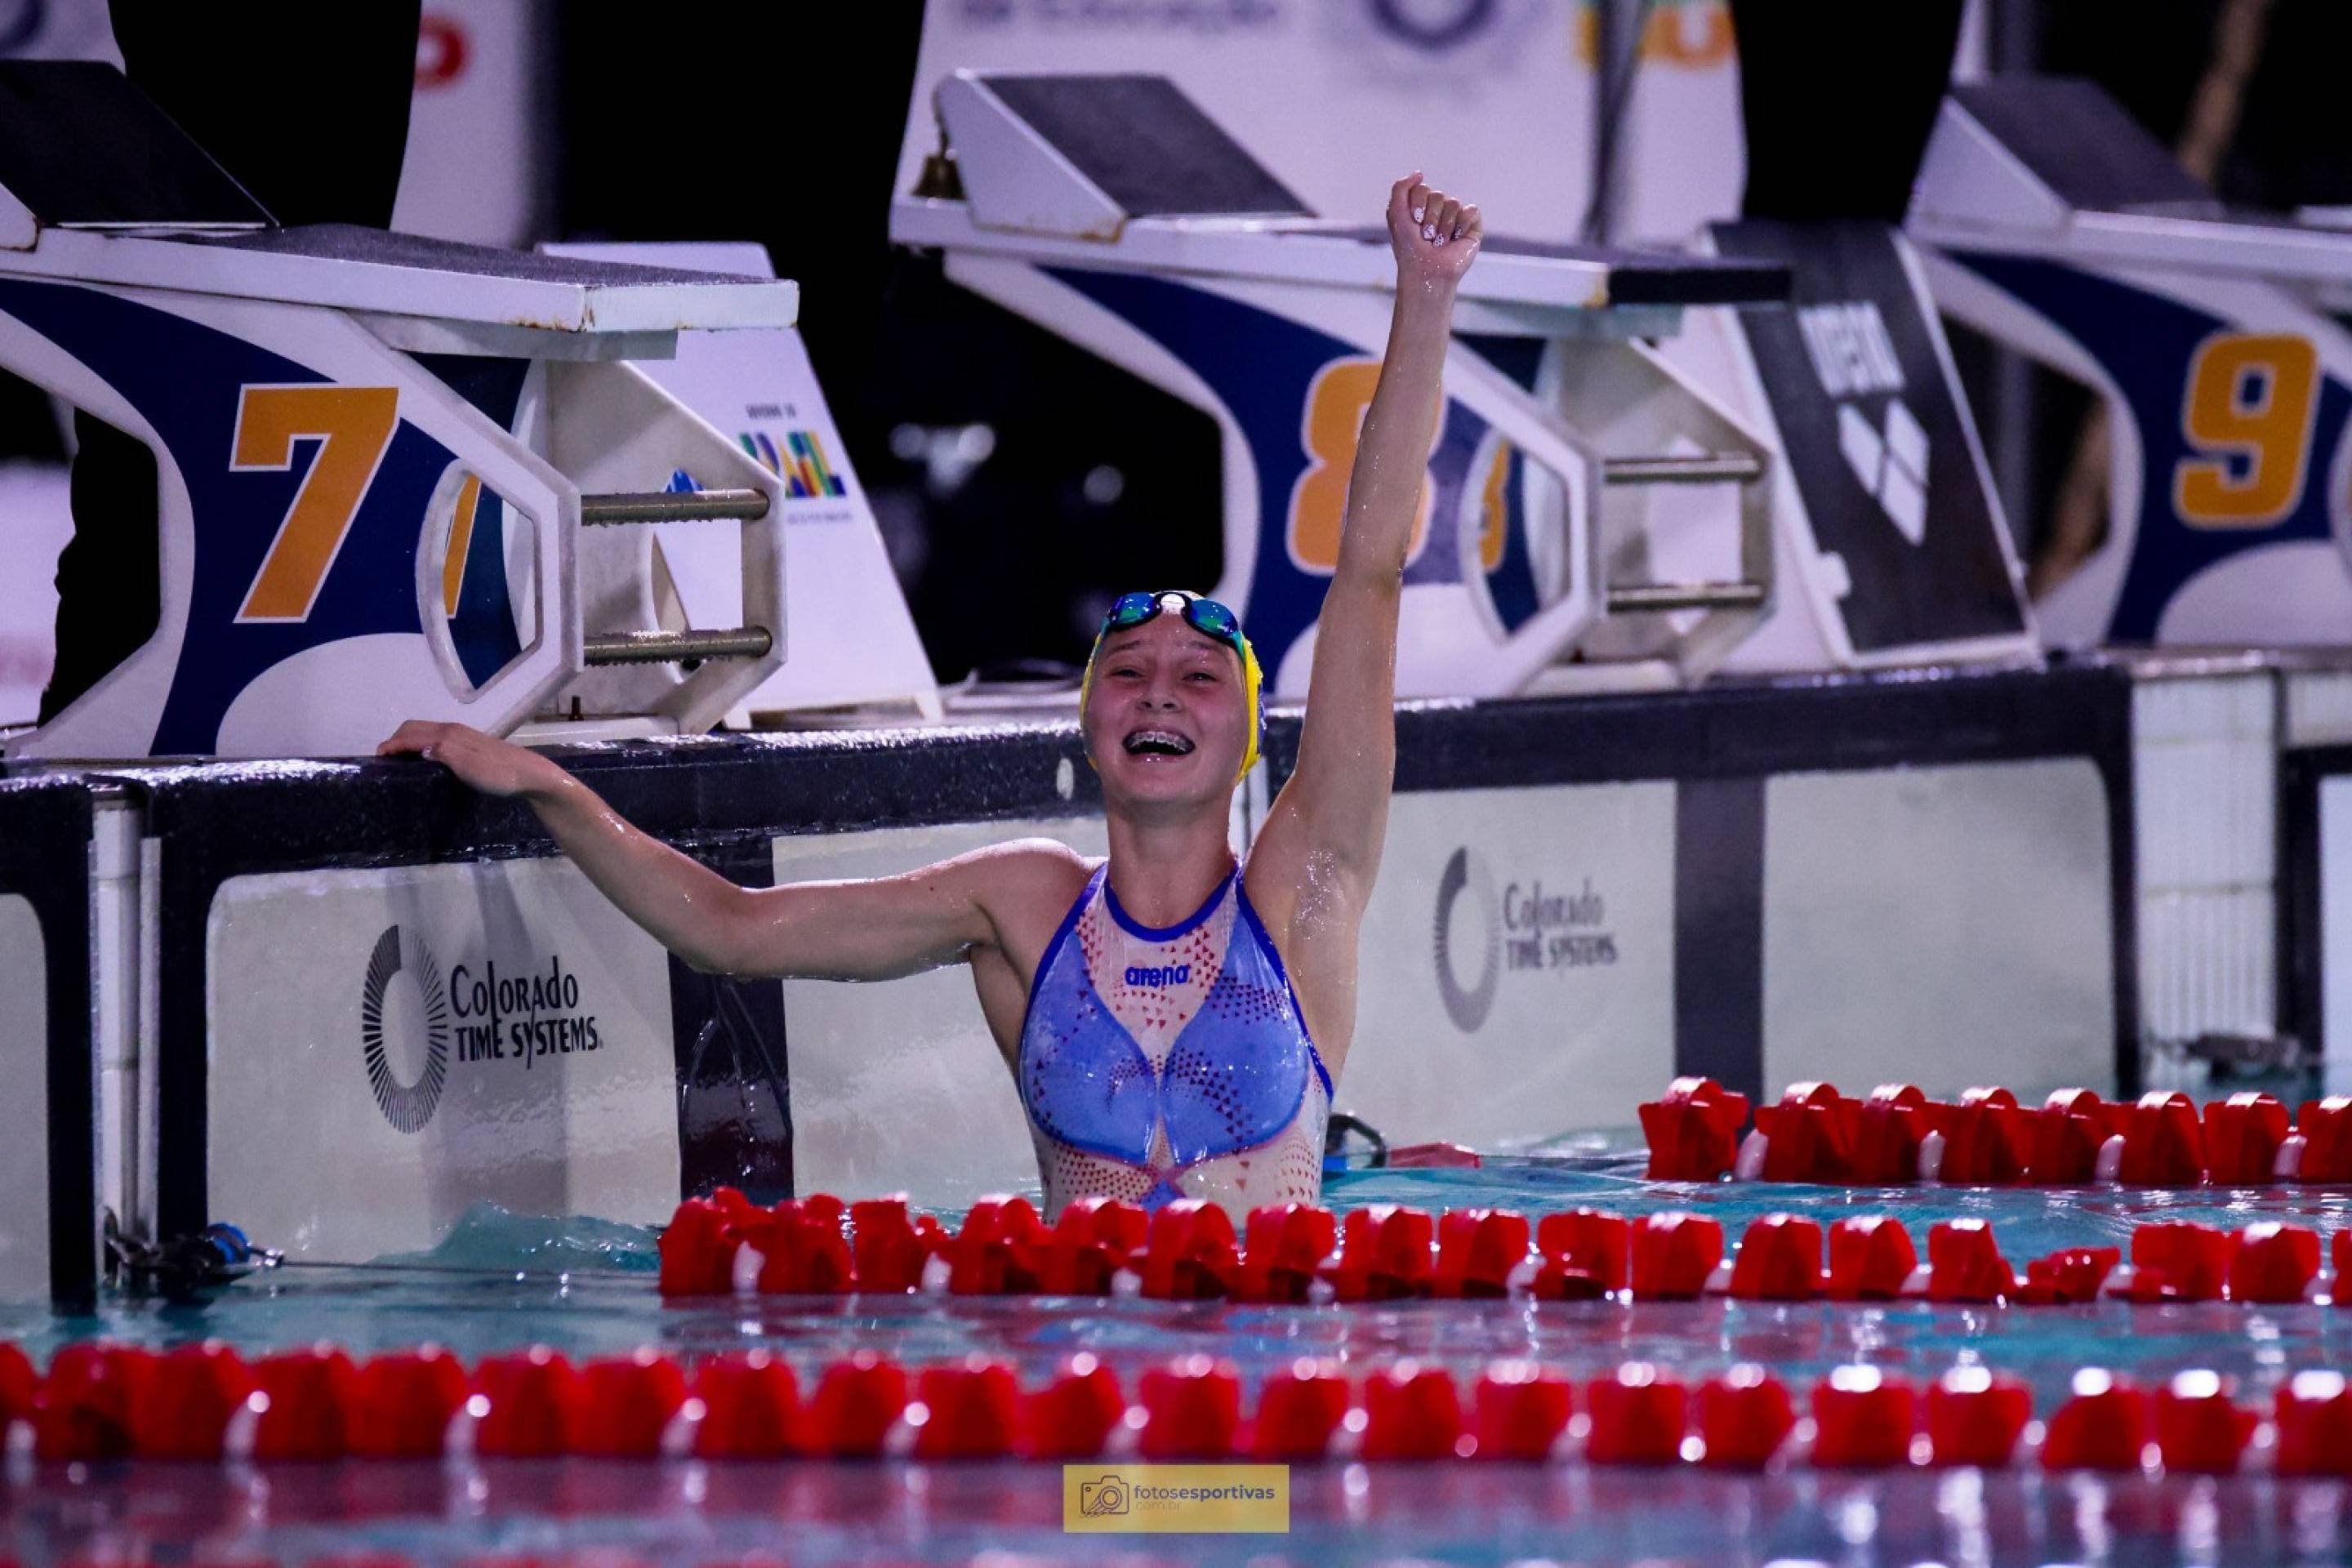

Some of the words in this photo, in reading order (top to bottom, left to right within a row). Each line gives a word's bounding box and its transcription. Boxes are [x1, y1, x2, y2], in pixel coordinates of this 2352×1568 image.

[2172, 331, 2321, 529] 9
[229, 384, 399, 623] 7
[1125, 965, 1188, 988] arena
[454, 1019, 504, 1062] TIME
[510, 1016, 599, 1070] SYSTEMS
